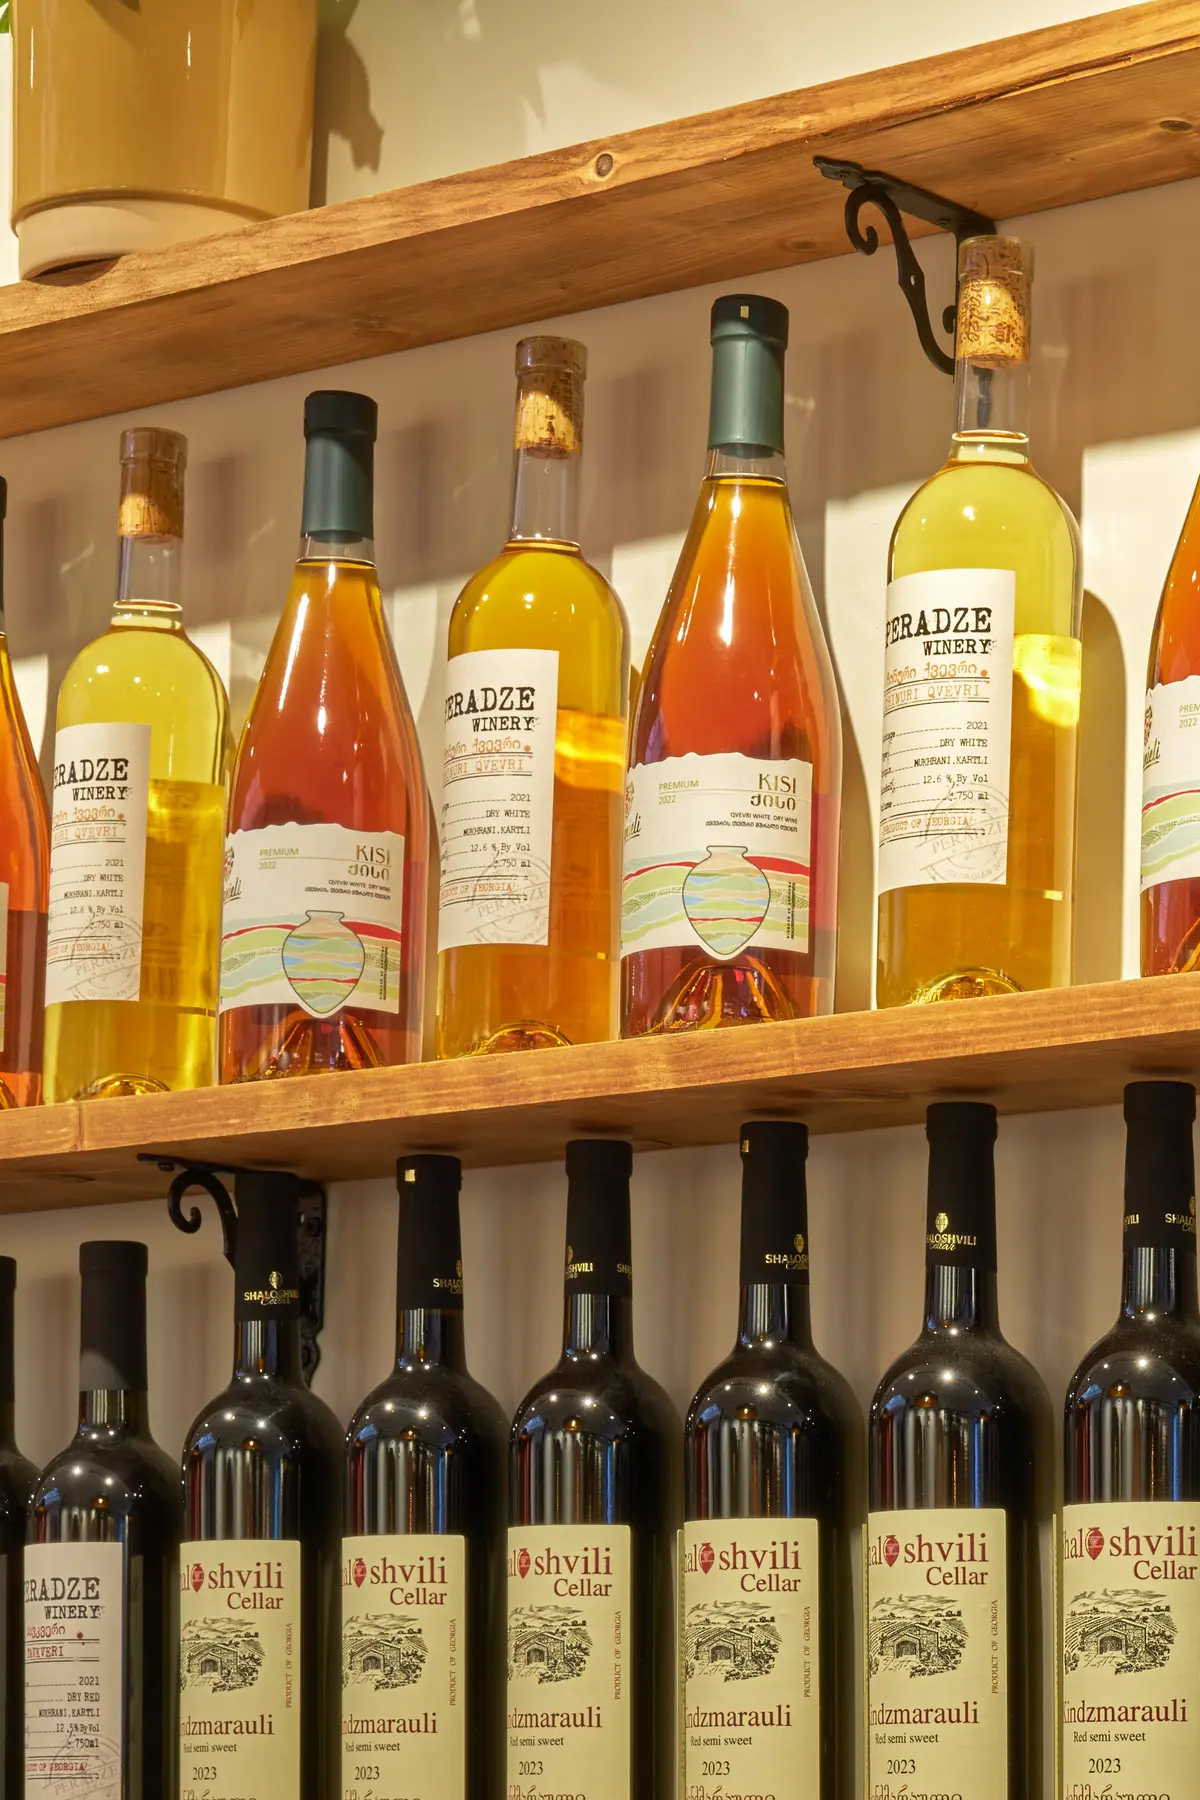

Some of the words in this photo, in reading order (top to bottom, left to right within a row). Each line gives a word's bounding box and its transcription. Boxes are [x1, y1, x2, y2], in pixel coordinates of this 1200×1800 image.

[885, 607, 992, 648] PERADZE
[923, 639, 991, 656] WINERY
[927, 683, 980, 699] QVEVRI
[472, 716, 534, 732] WINERY
[966, 721, 988, 730] 2021
[1178, 718, 1197, 729] 2022
[960, 738, 988, 747] WHITE
[475, 758, 524, 771] QVEVRI
[658, 780, 699, 791] PREMIUM
[759, 773, 796, 794] KISI
[72, 786, 128, 801] WINERY
[510, 793, 531, 802] 2021
[658, 795, 676, 805] 2022
[259, 848, 299, 857] PREMIUM
[355, 844, 391, 864] KISI
[105, 859, 124, 867] 2021
[925, 1566, 989, 1586] Cellar
[1134, 1559, 1198, 1581] Cellar
[553, 1578, 612, 1598] Cellar
[740, 1573, 801, 1593] Cellar
[227, 1592, 284, 1611] Cellar
[389, 1587, 447, 1606] Cellar
[44, 1605, 100, 1619] WINERY
[79, 1676, 100, 1686] 2021
[192, 1766, 218, 1781] 2023
[354, 1766, 380, 1781] 2023
[518, 1761, 544, 1776] 2023
[702, 1760, 731, 1777] 2023
[886, 1759, 916, 1775] 2023
[1088, 1758, 1122, 1775] 2023
